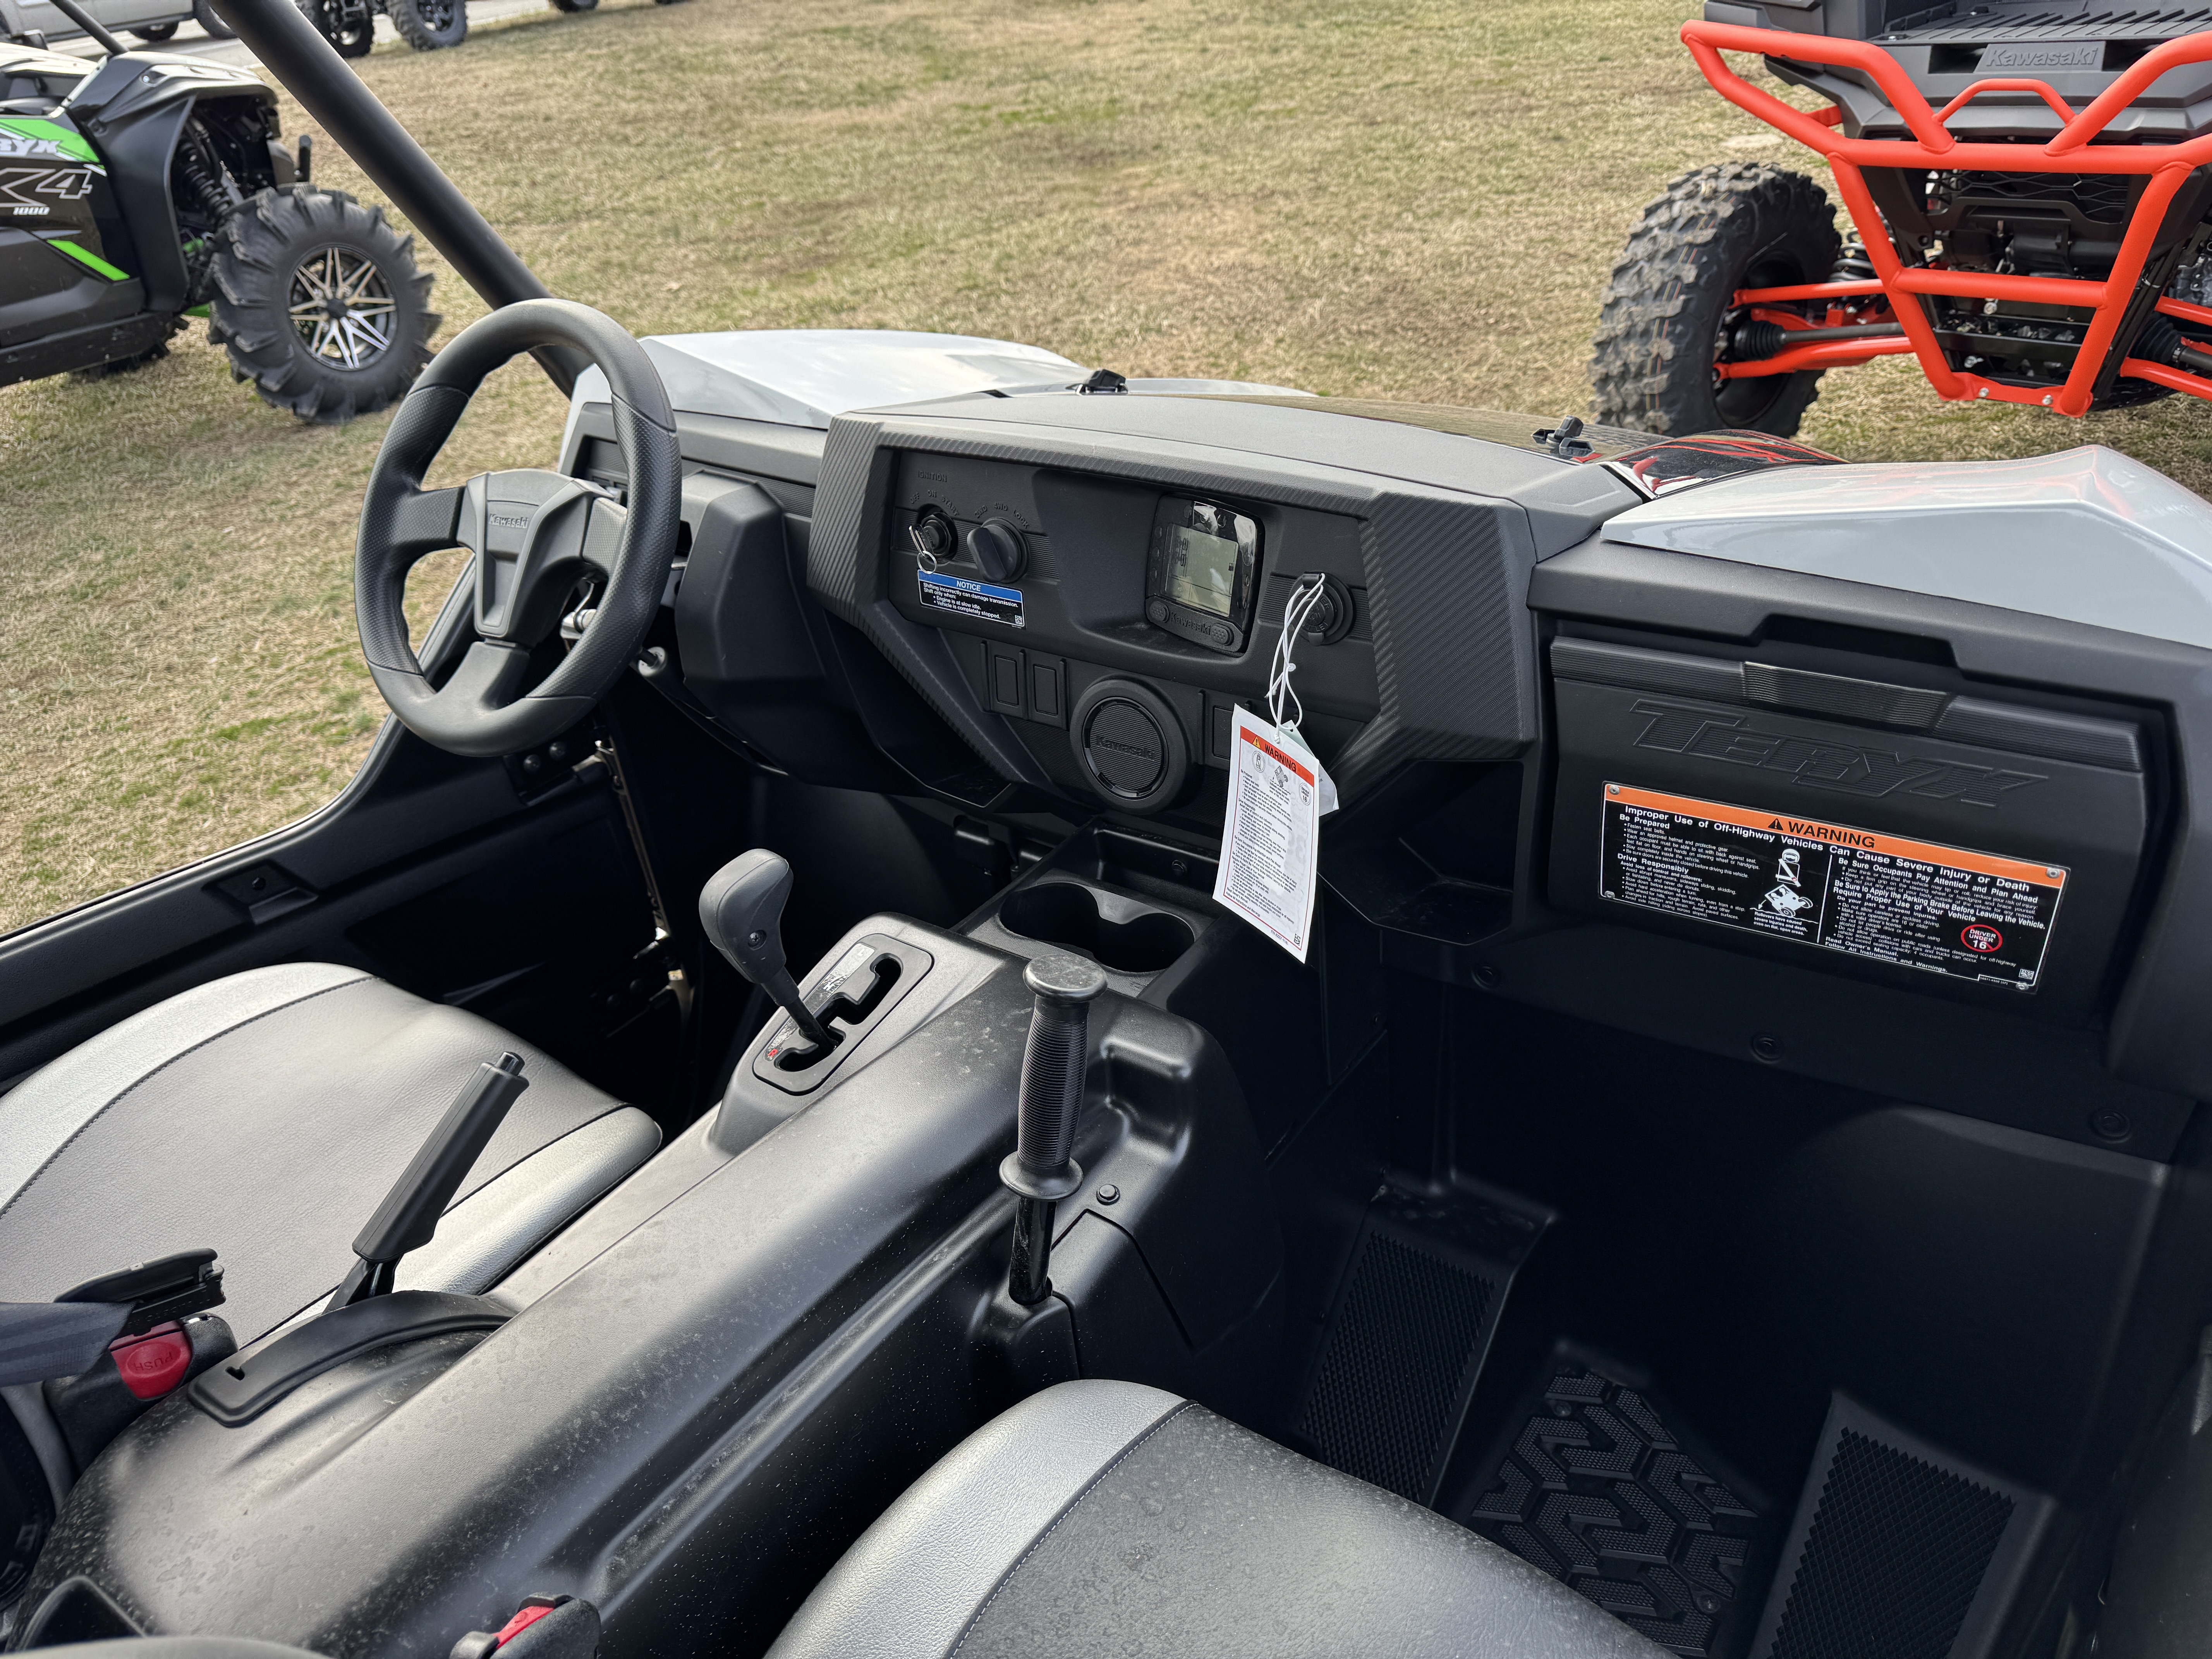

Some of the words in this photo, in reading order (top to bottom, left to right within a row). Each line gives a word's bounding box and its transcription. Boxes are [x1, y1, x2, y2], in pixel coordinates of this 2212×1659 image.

[1986, 47, 2099, 67] Kawasaki
[13, 206, 50, 216] 1000
[918, 471, 947, 483] IGNITION
[910, 492, 920, 504] OFF
[941, 495, 959, 516] START
[994, 502, 1008, 511] 4WD
[489, 514, 529, 529] Kawasaki
[1013, 509, 1029, 529] LOCK
[923, 582, 939, 591] Shifting
[939, 586, 962, 596] incorrectly
[989, 597, 1018, 607] transmission.
[957, 580, 981, 591] NOTICE
[1170, 611, 1211, 636] Kawasaki
[1096, 735, 1156, 761] Kawasaki
[1265, 742, 1297, 772] WARNING
[1634, 816, 1669, 829] Prepared
[1788, 821, 1874, 848] WARNING
[1625, 805, 1669, 820] Improper
[1674, 815, 1693, 825] Use
[1714, 823, 1775, 842] Off-Highway
[1781, 836, 1823, 850] Vehicles
[1829, 845, 1850, 856] Can
[1856, 851, 1889, 863] Cause
[1896, 859, 1933, 872] Severe
[1940, 867, 1971, 881] Injury
[1996, 878, 2029, 891] Death
[1618, 853, 1637, 862] Drive
[1641, 858, 1688, 874] Responsibly
[1852, 860, 1869, 869] Sure
[1873, 864, 1912, 878] Occupants
[1916, 873, 1930, 883] Pay
[1934, 877, 1968, 889] Attention
[1991, 888, 2008, 897] Plan
[2012, 893, 2038, 903] Ahead
[1833, 886, 1862, 898] Require
[1866, 893, 1891, 903] Proper
[1896, 899, 1910, 908] Use
[1927, 906, 1943, 915] Your
[1948, 910, 1975, 921] Vehicle
[1845, 882, 1860, 890] Sure
[1870, 887, 1889, 897] Apply
[1903, 894, 1928, 906] Parking
[1930, 899, 1949, 909] Brake
[1951, 904, 1974, 914] Before
[1976, 909, 2003, 921] Leaving
[2018, 917, 2045, 929] Vehicle.
[1913, 911, 1937, 920] injuries:
[1969, 933, 1993, 942] UNDER
[1970, 929, 1996, 938] DRIVER
[1845, 941, 1870, 950] Owner's
[1874, 947, 1898, 956] Manual.
[1973, 940, 1987, 949] 16
[1860, 949, 1896, 961] Instructions
[1916, 962, 1947, 972] Warnings.
[134, 1352, 173, 1371] PUSH
